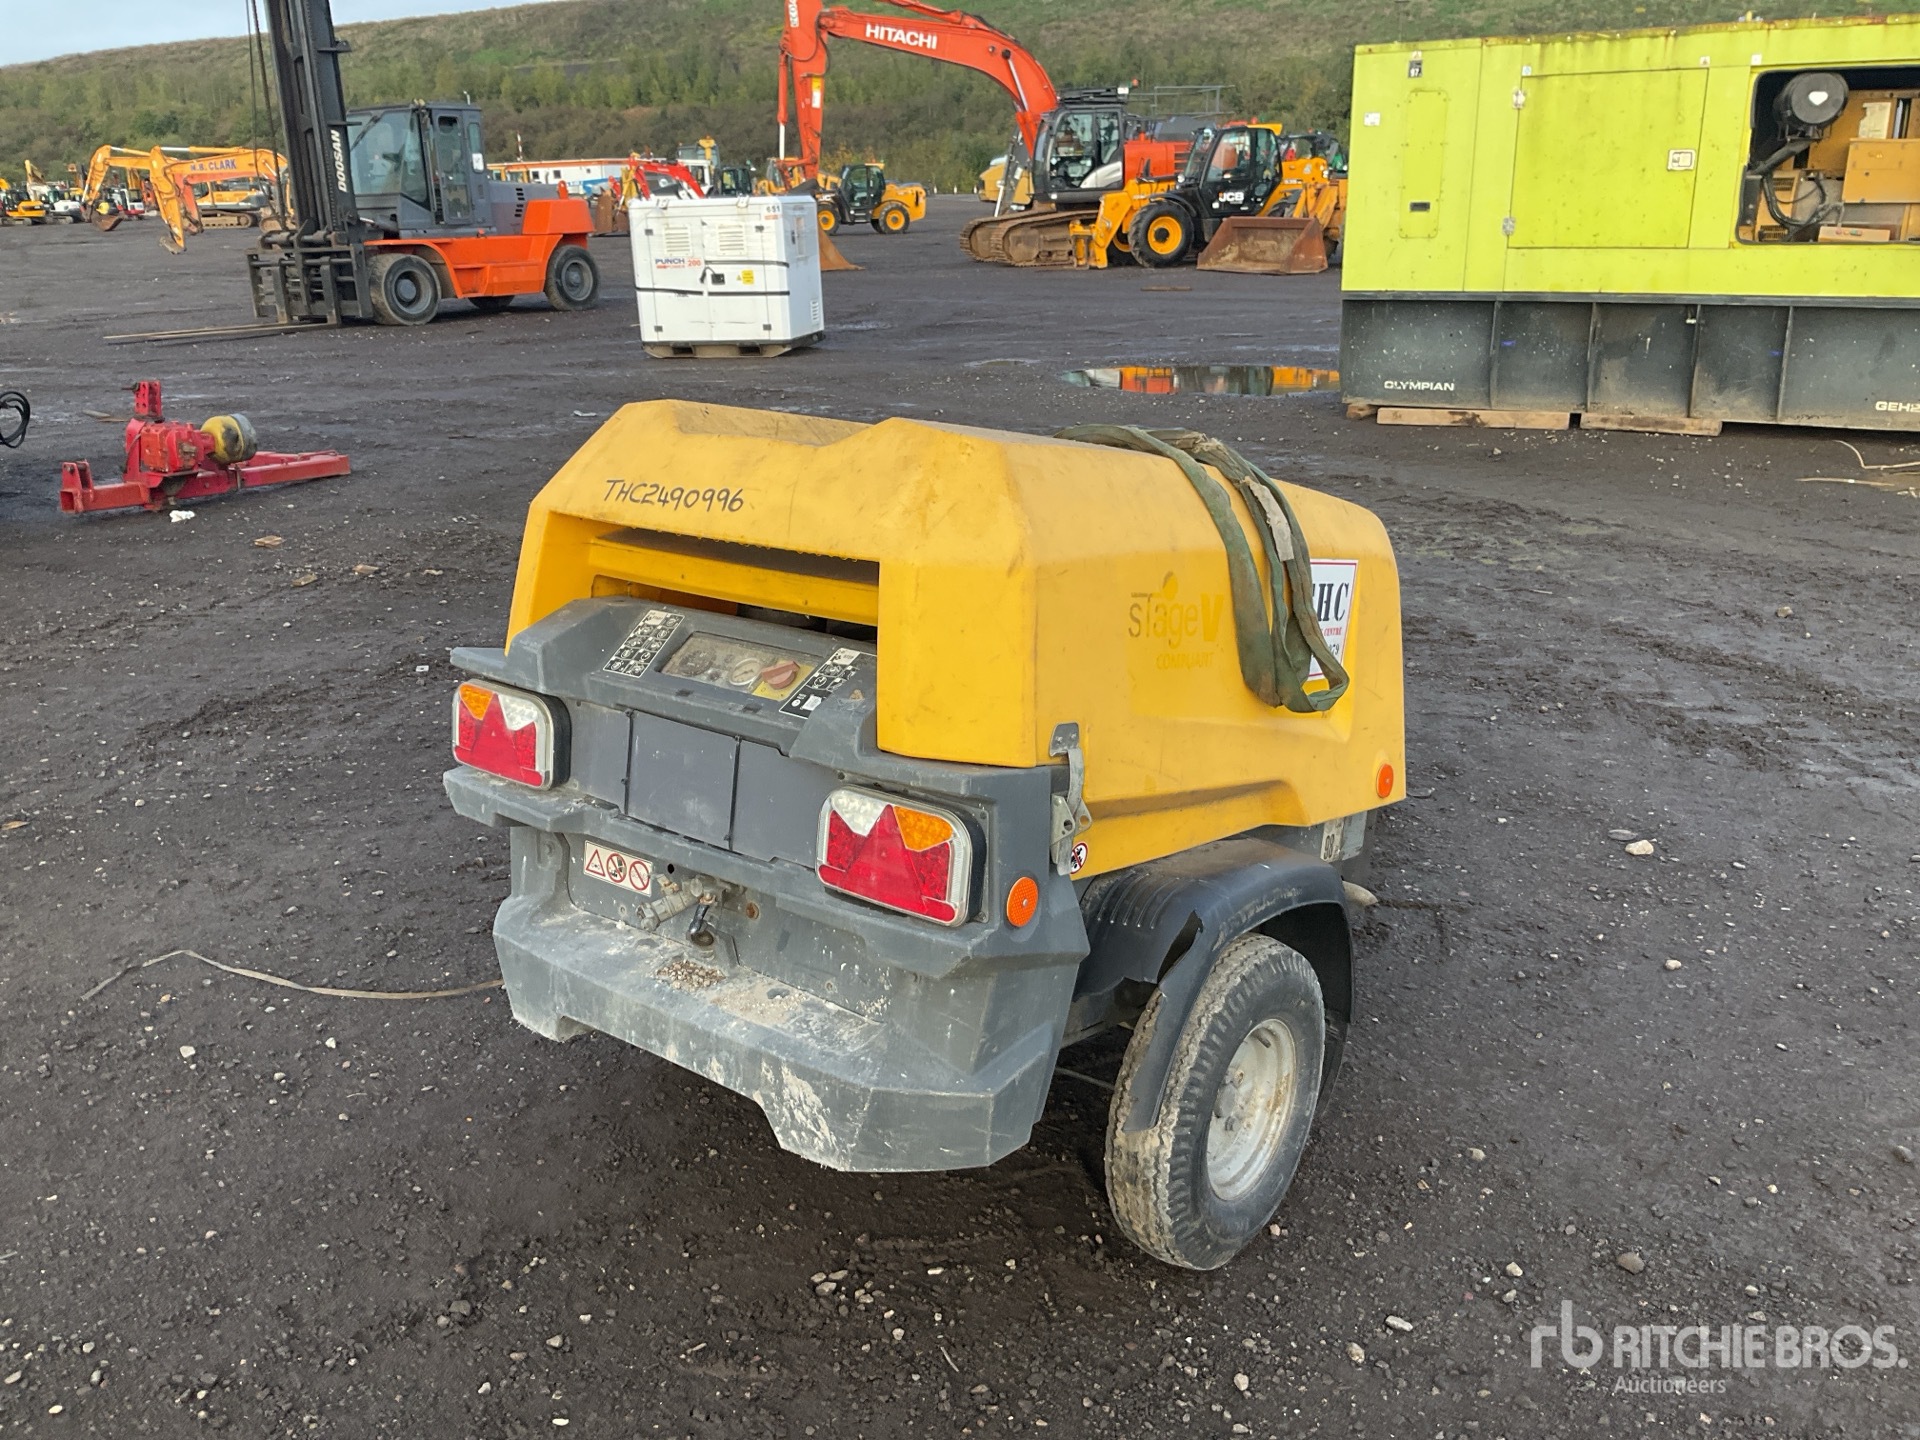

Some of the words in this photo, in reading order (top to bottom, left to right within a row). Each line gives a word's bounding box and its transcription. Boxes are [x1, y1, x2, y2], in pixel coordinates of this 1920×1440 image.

[865, 23, 938, 50] HITACHI
[208, 158, 237, 171] CLARK
[330, 129, 348, 193] DOOSAN
[1218, 191, 1245, 202] JCB
[1384, 380, 1455, 391] OLYMPIAN
[603, 479, 745, 512] THC2490996
[1312, 582, 1349, 622] HC
